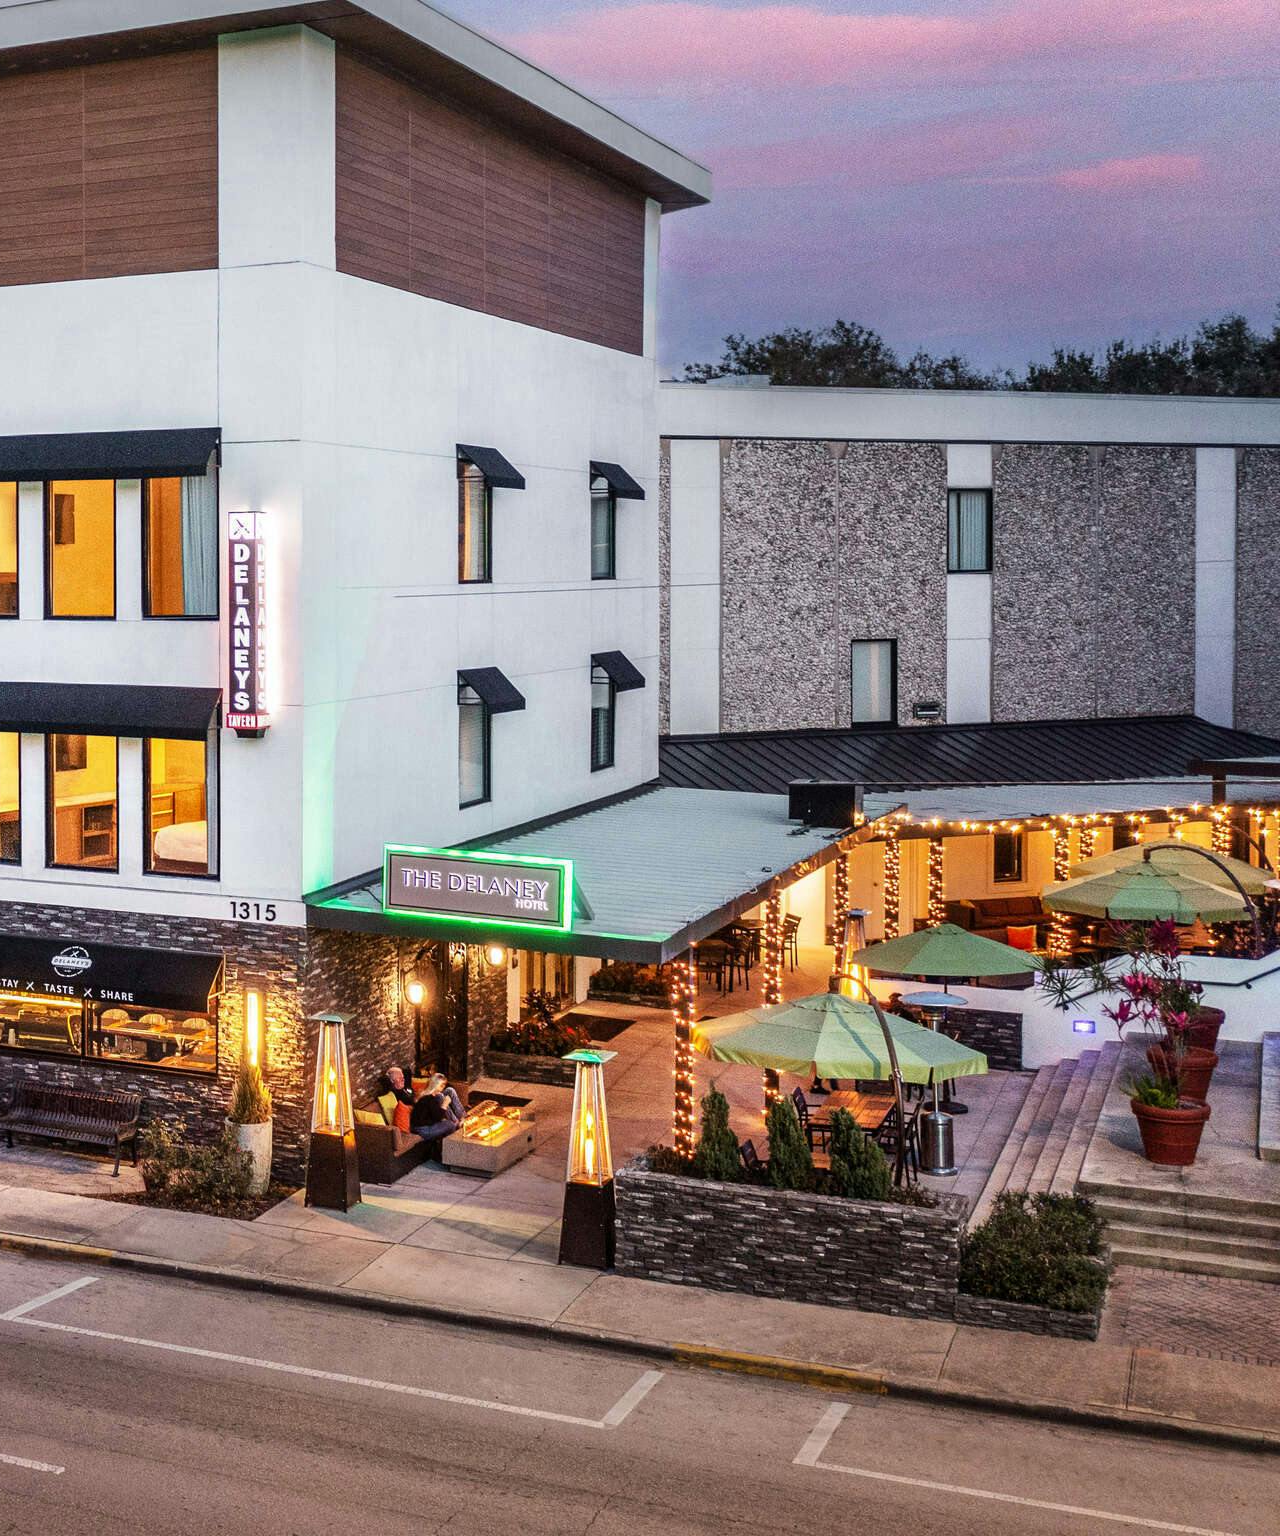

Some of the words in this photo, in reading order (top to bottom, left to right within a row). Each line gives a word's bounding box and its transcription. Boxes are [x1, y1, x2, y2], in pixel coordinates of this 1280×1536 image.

[233, 543, 251, 711] DELANEYS
[227, 714, 256, 728] TAVERN
[401, 867, 442, 890] THE
[448, 872, 549, 900] DELANEY
[230, 901, 276, 921] 1315
[514, 898, 549, 911] HOTEL
[44, 983, 74, 995] TASTE
[100, 989, 134, 1002] SHARE
